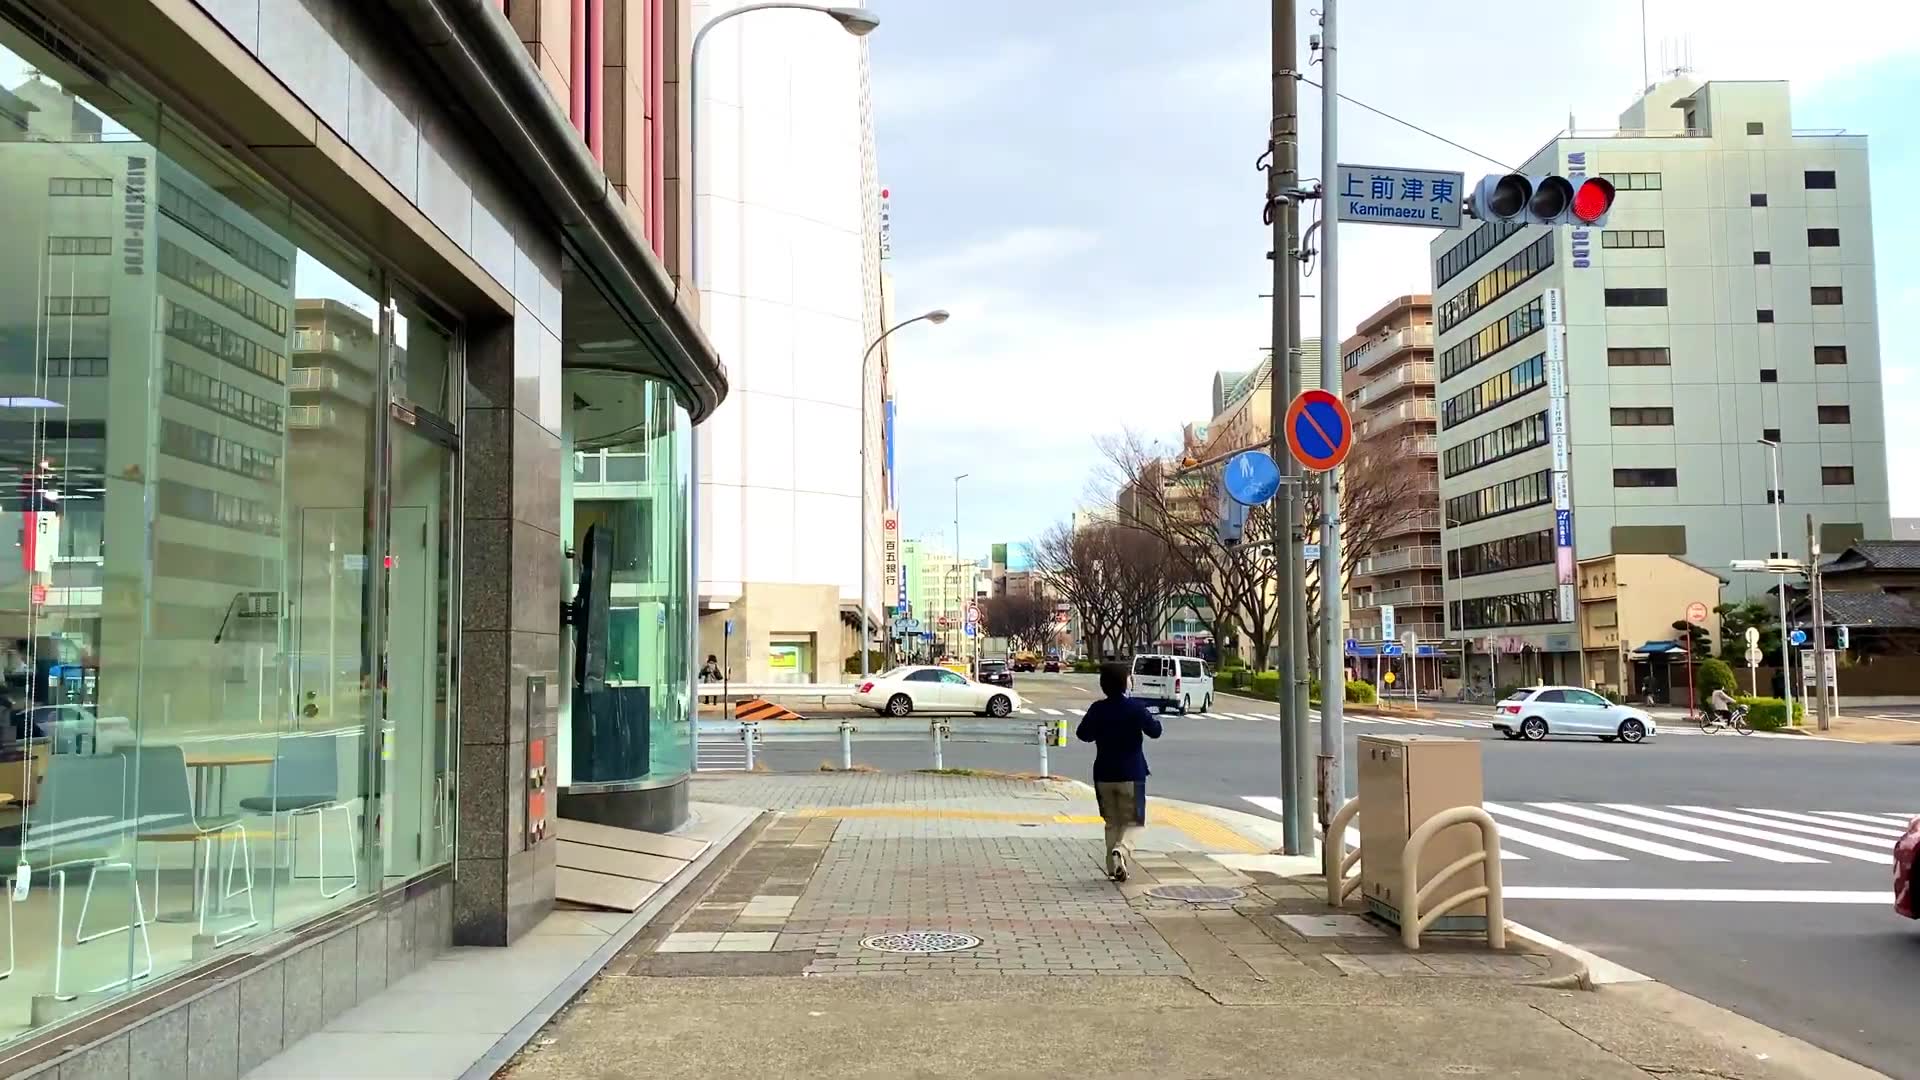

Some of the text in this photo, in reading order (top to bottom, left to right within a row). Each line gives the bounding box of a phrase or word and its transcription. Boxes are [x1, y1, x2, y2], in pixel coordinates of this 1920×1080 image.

[1340, 172, 1455, 204] 上前津東
[1350, 202, 1443, 221] Kamimaezu E.
[885, 541, 896, 586] 百五銀行
